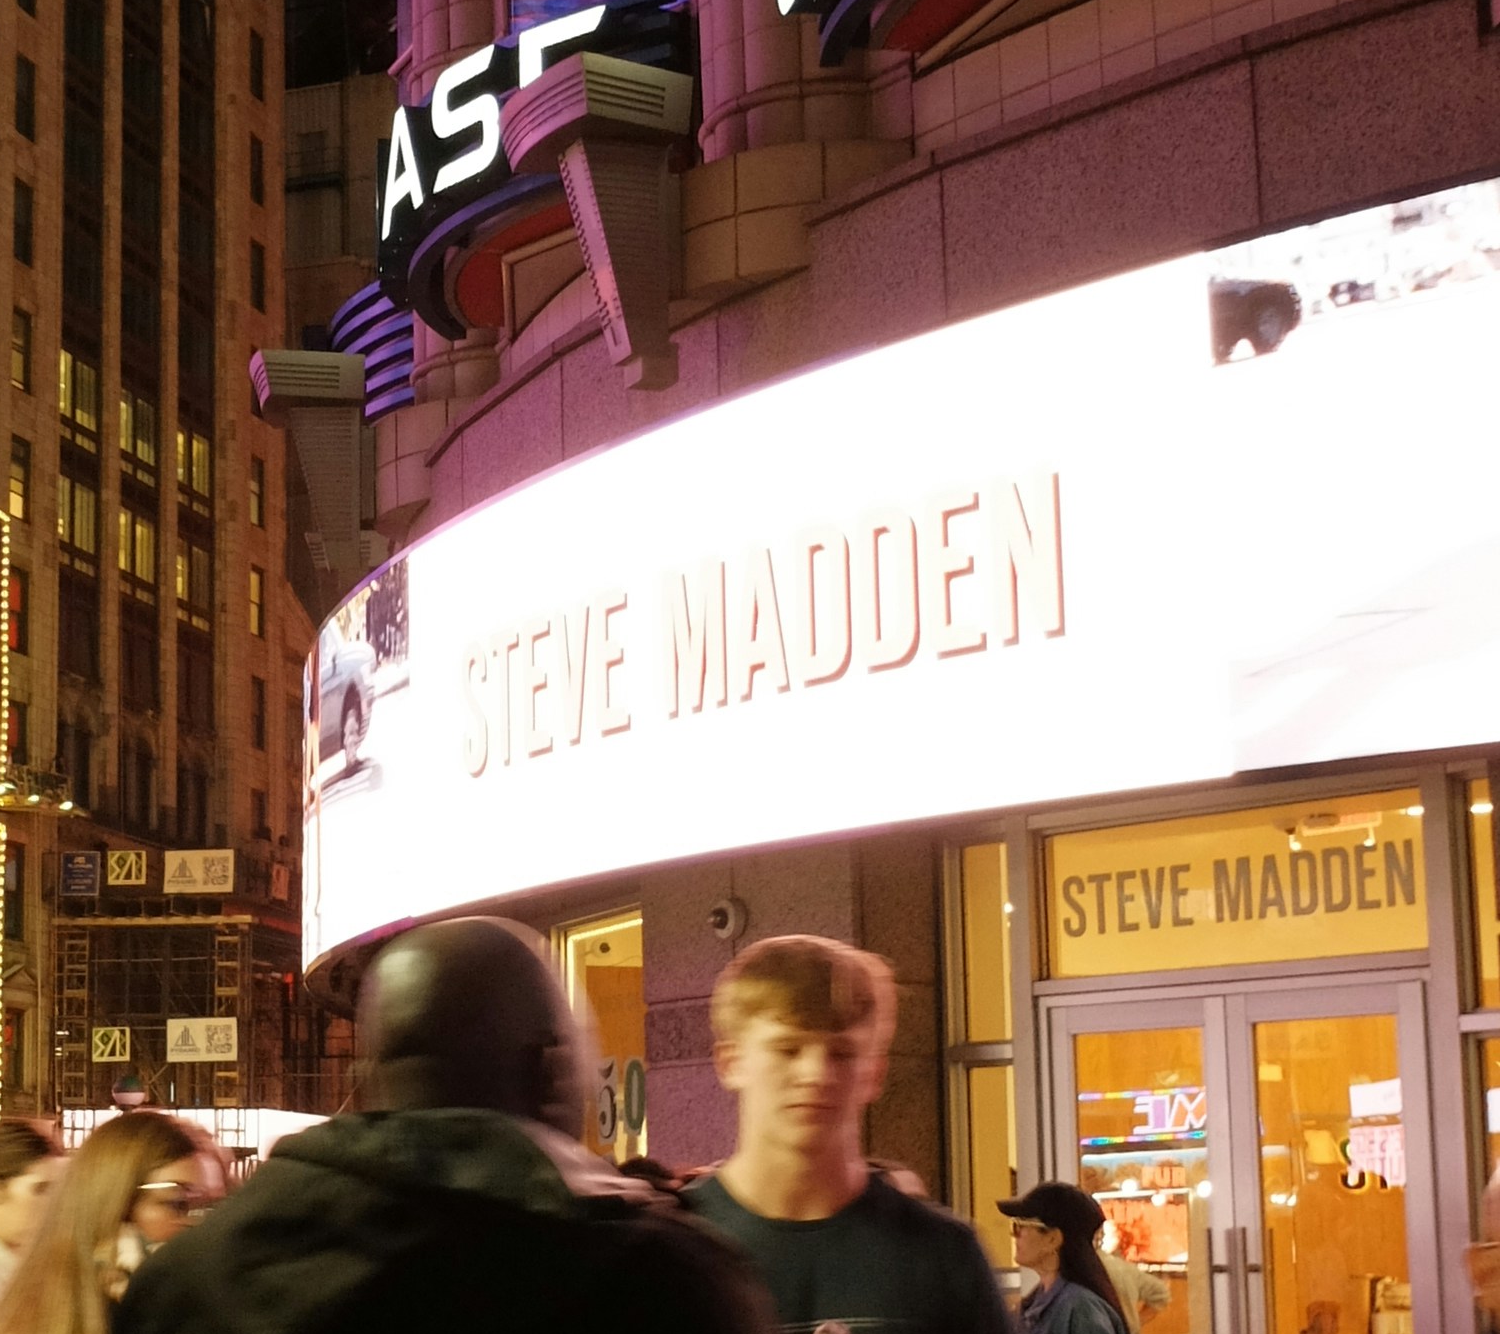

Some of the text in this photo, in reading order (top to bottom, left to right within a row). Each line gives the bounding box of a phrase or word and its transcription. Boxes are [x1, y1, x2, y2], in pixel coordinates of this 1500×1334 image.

[461, 470, 1066, 778] STEVE MADDEN
[1061, 838, 1417, 938] STEVE MADDEN
